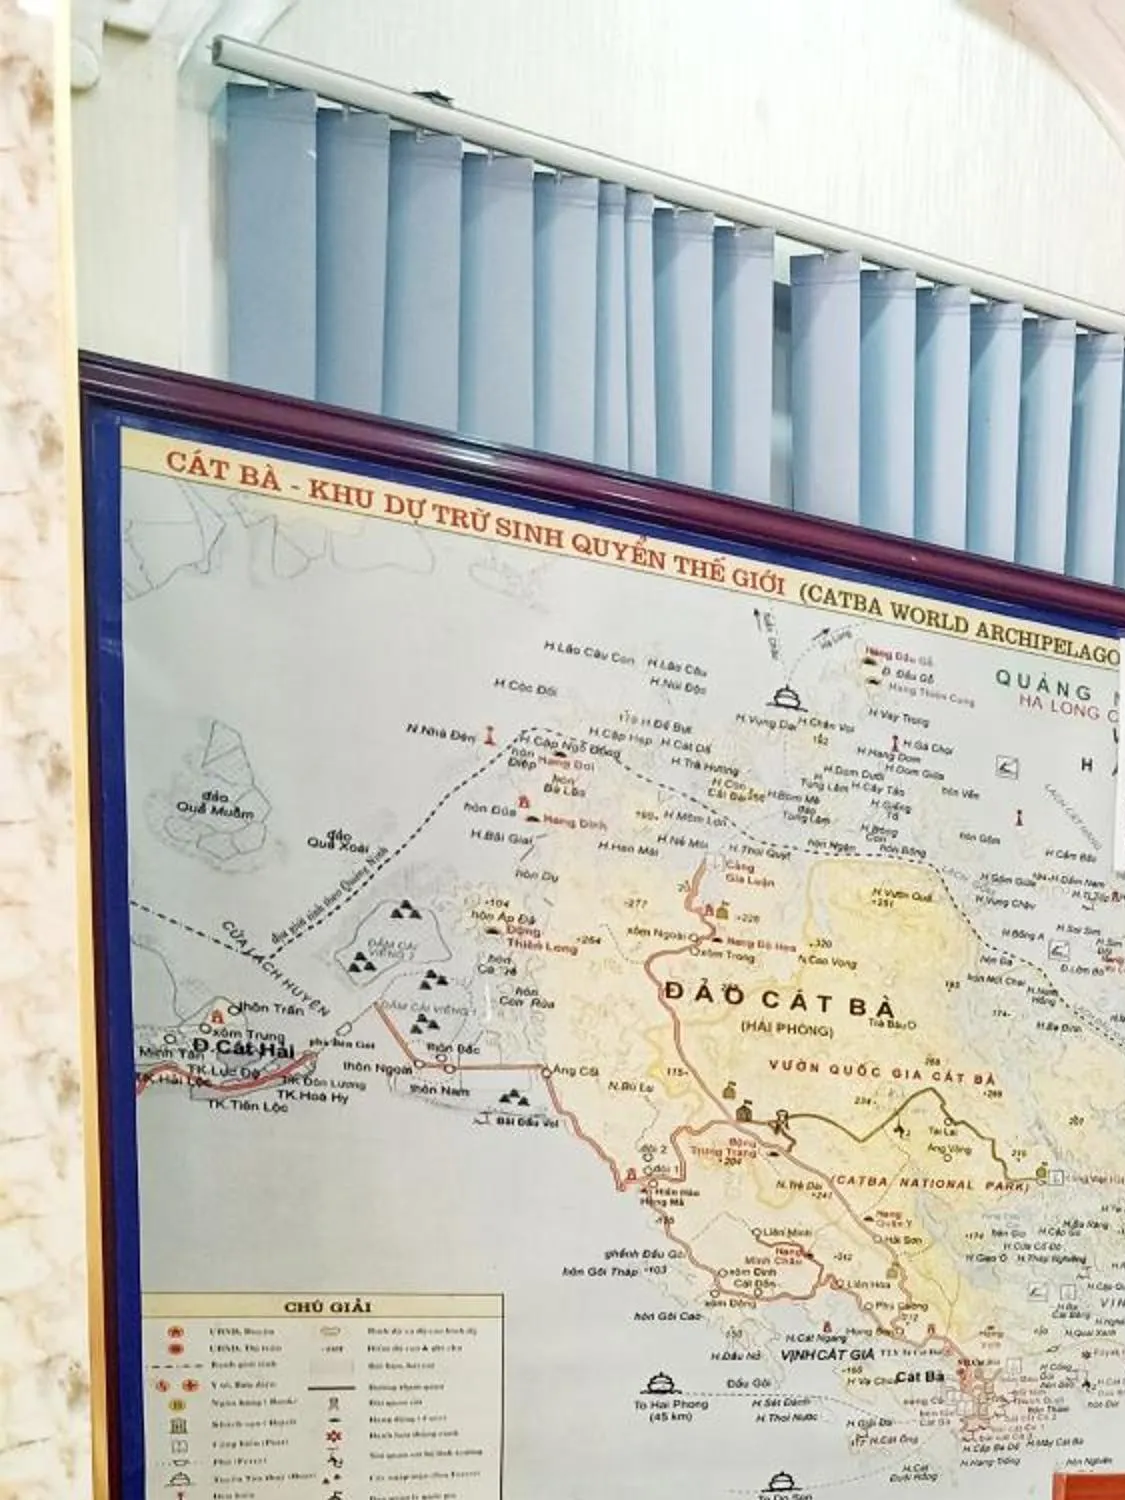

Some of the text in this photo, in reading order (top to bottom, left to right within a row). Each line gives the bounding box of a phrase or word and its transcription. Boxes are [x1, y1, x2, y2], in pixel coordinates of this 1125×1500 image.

[166, 449, 230, 481] CÁT
[239, 464, 282, 491] BÀ
[308, 478, 375, 508] KHU
[495, 518, 564, 549] SINH
[673, 554, 726, 583] THẾ
[732, 568, 785, 596] GIỚI
[890, 602, 969, 634] WORLD
[975, 621, 1121, 667] ARCHIPELAGO
[1049, 698, 1101, 721] LONG
[665, 977, 896, 1019] ĐẢO CÁT BÀ
[899, 1177, 973, 1191] NATIONAL
[284, 1299, 373, 1315] CHÚ GIẢI
[672, 1400, 709, 1411] Phong
